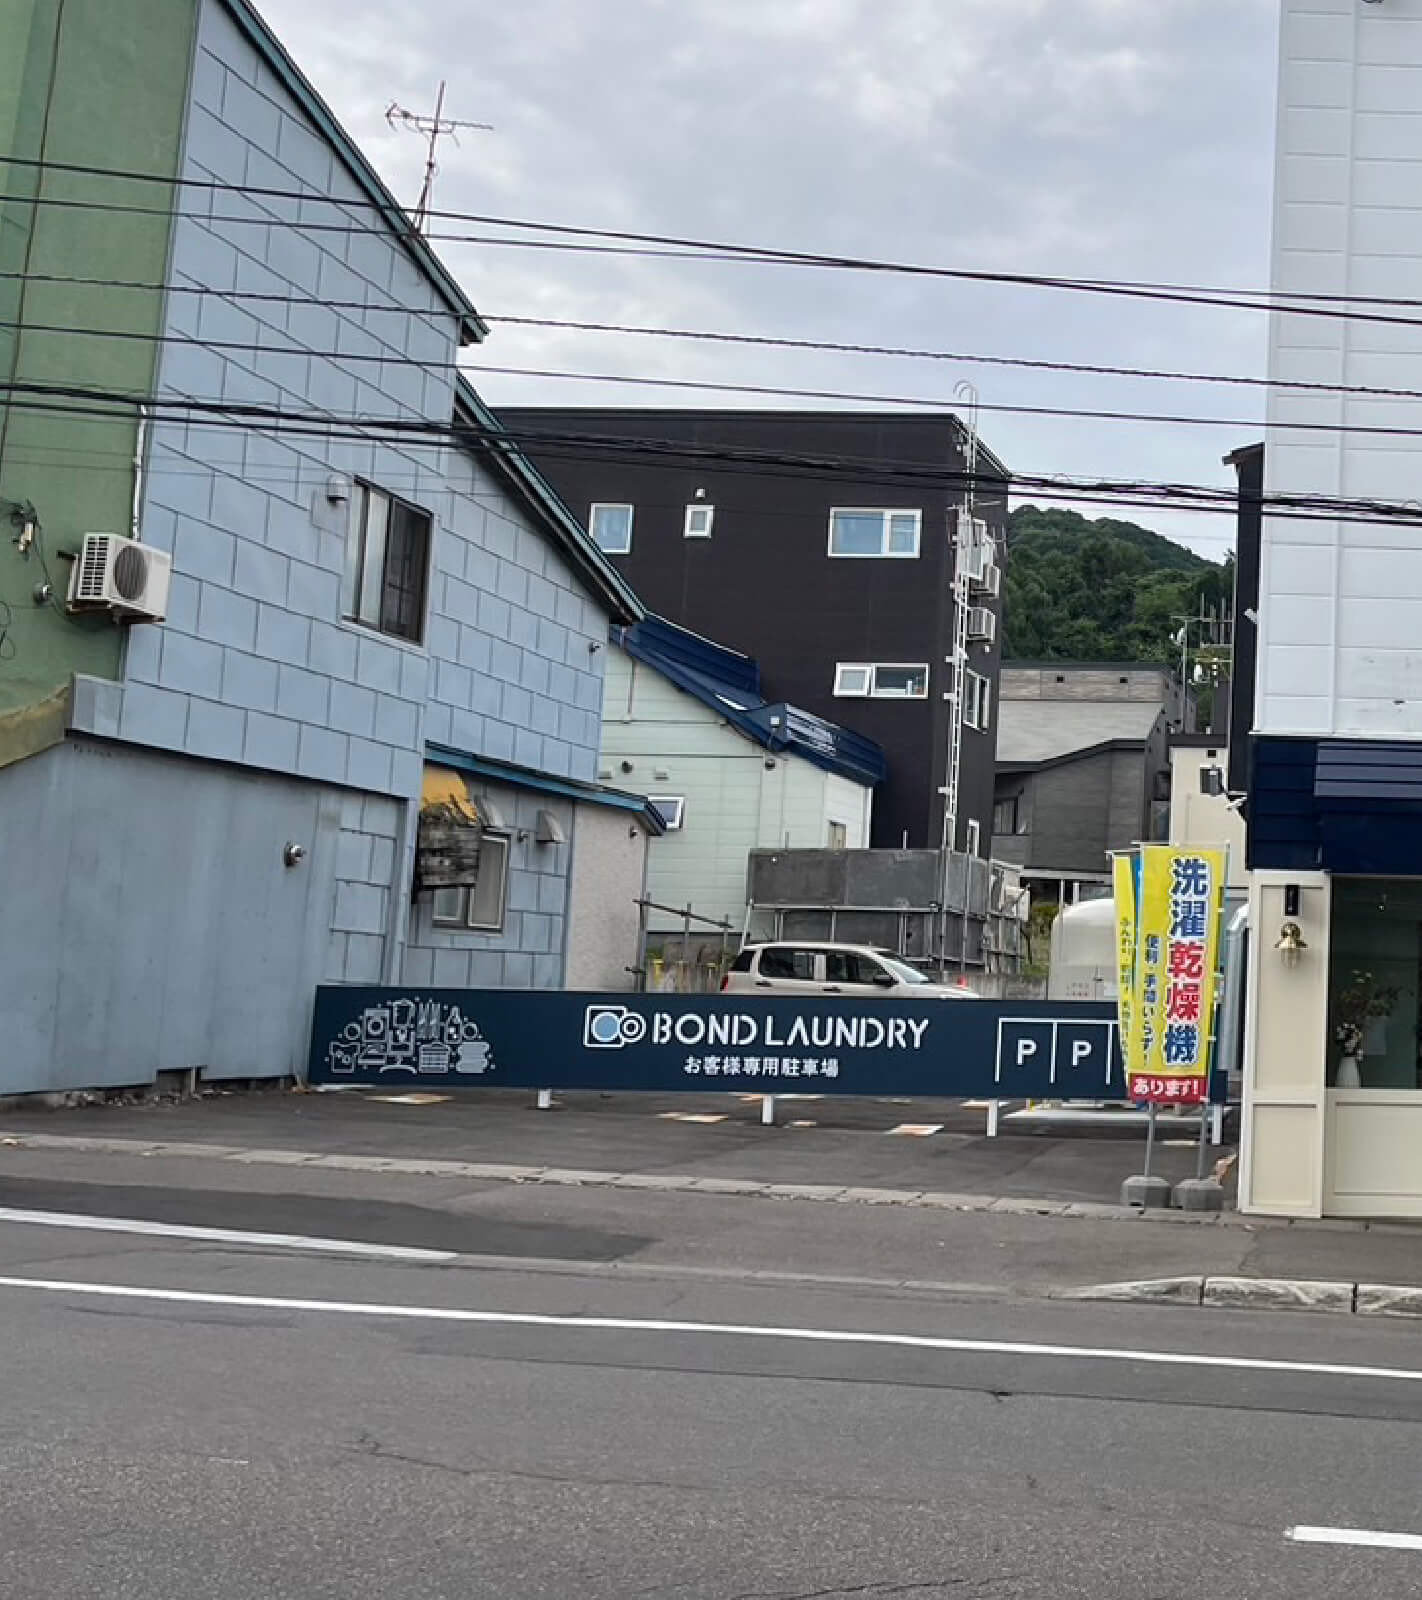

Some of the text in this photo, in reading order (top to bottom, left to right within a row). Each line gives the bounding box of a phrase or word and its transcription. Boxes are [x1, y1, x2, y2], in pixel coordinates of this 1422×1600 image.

[1164, 857, 1208, 1064] 洗濯乾燥機
[653, 1013, 930, 1049] BOND LAUNDRY
[1018, 1040, 1037, 1066] P
[1073, 1040, 1092, 1066] P
[684, 1055, 839, 1078] お客様専用駐車場
